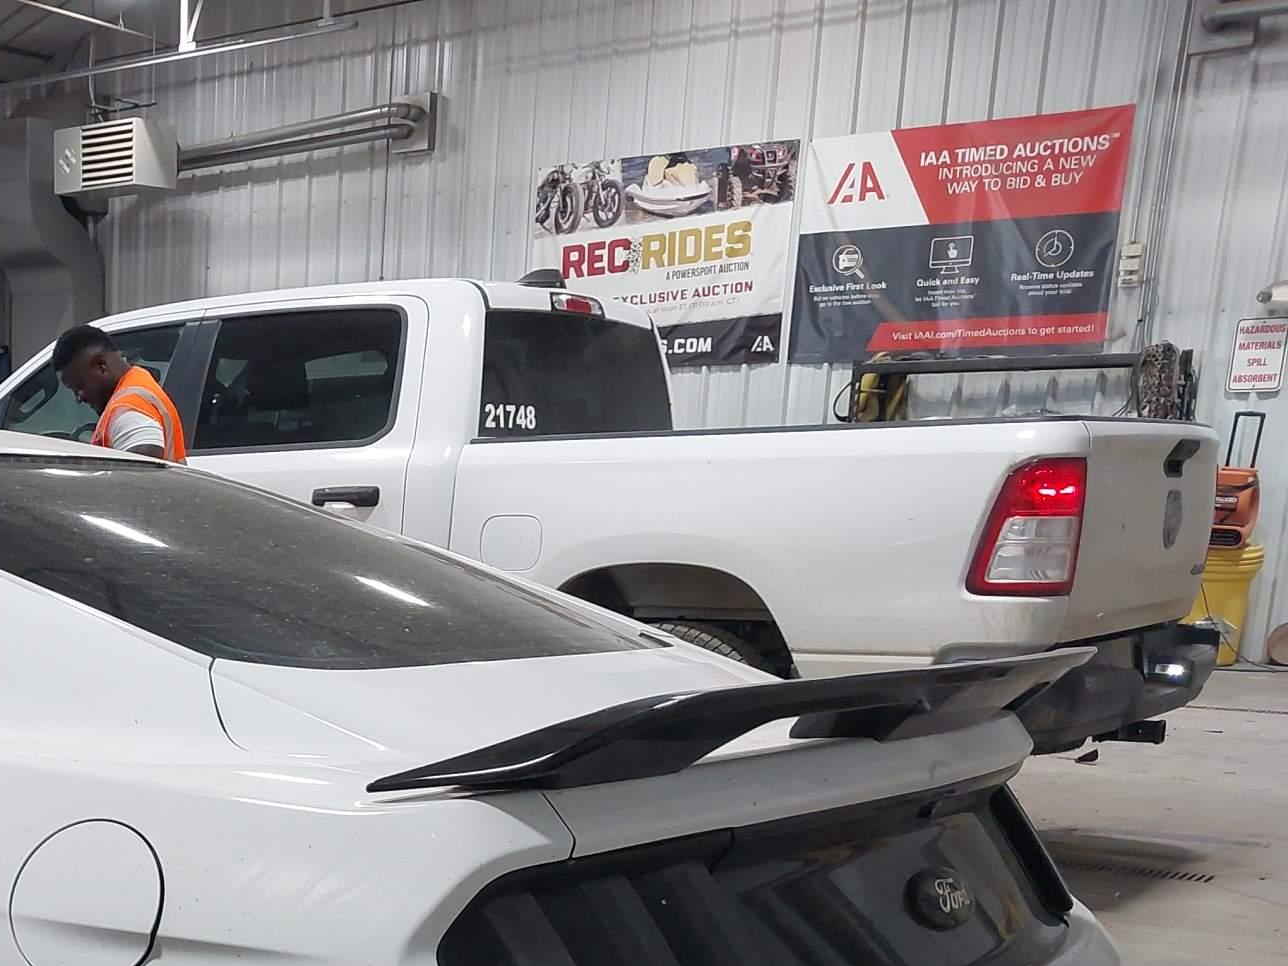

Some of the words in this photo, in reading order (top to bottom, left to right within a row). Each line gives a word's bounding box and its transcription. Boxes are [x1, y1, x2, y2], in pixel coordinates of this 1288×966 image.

[920, 151, 950, 166] IAA
[955, 145, 1008, 163] TIMED
[939, 159, 1038, 180] INTRODUCING
[1043, 158, 1054, 172] A
[1059, 154, 1097, 170] NEW
[947, 180, 979, 195] WAY
[983, 177, 1001, 191] TO
[1006, 175, 1031, 189] BID
[1035, 174, 1046, 187] &
[1051, 171, 1083, 186] BUY
[562, 237, 632, 279] REC
[641, 219, 753, 270] RIDES
[665, 271, 672, 281] A
[672, 266, 717, 280] POWERSPORT
[718, 261, 750, 273] AUCTION
[1011, 272, 1054, 281] Real-Time
[1057, 270, 1094, 281] Updates
[691, 280, 754, 298] AUCTION
[809, 283, 844, 293] Exclusive
[845, 282, 863, 291] First
[866, 280, 887, 290] Look
[916, 278, 940, 287] Quick
[942, 277, 958, 285] and
[960, 275, 980, 286] Easy
[892, 331, 912, 341] Visit
[1027, 326, 1038, 336] to
[1039, 326, 1055, 338] get
[1057, 323, 1095, 335] started!
[1239, 323, 1287, 334] HAZARDOUS
[1238, 340, 1282, 351] MATERIALS
[1247, 357, 1268, 367] SPILL
[1232, 373, 1279, 383] ABSORBENT
[484, 403, 537, 430] 21748
[935, 877, 971, 914] Ford
